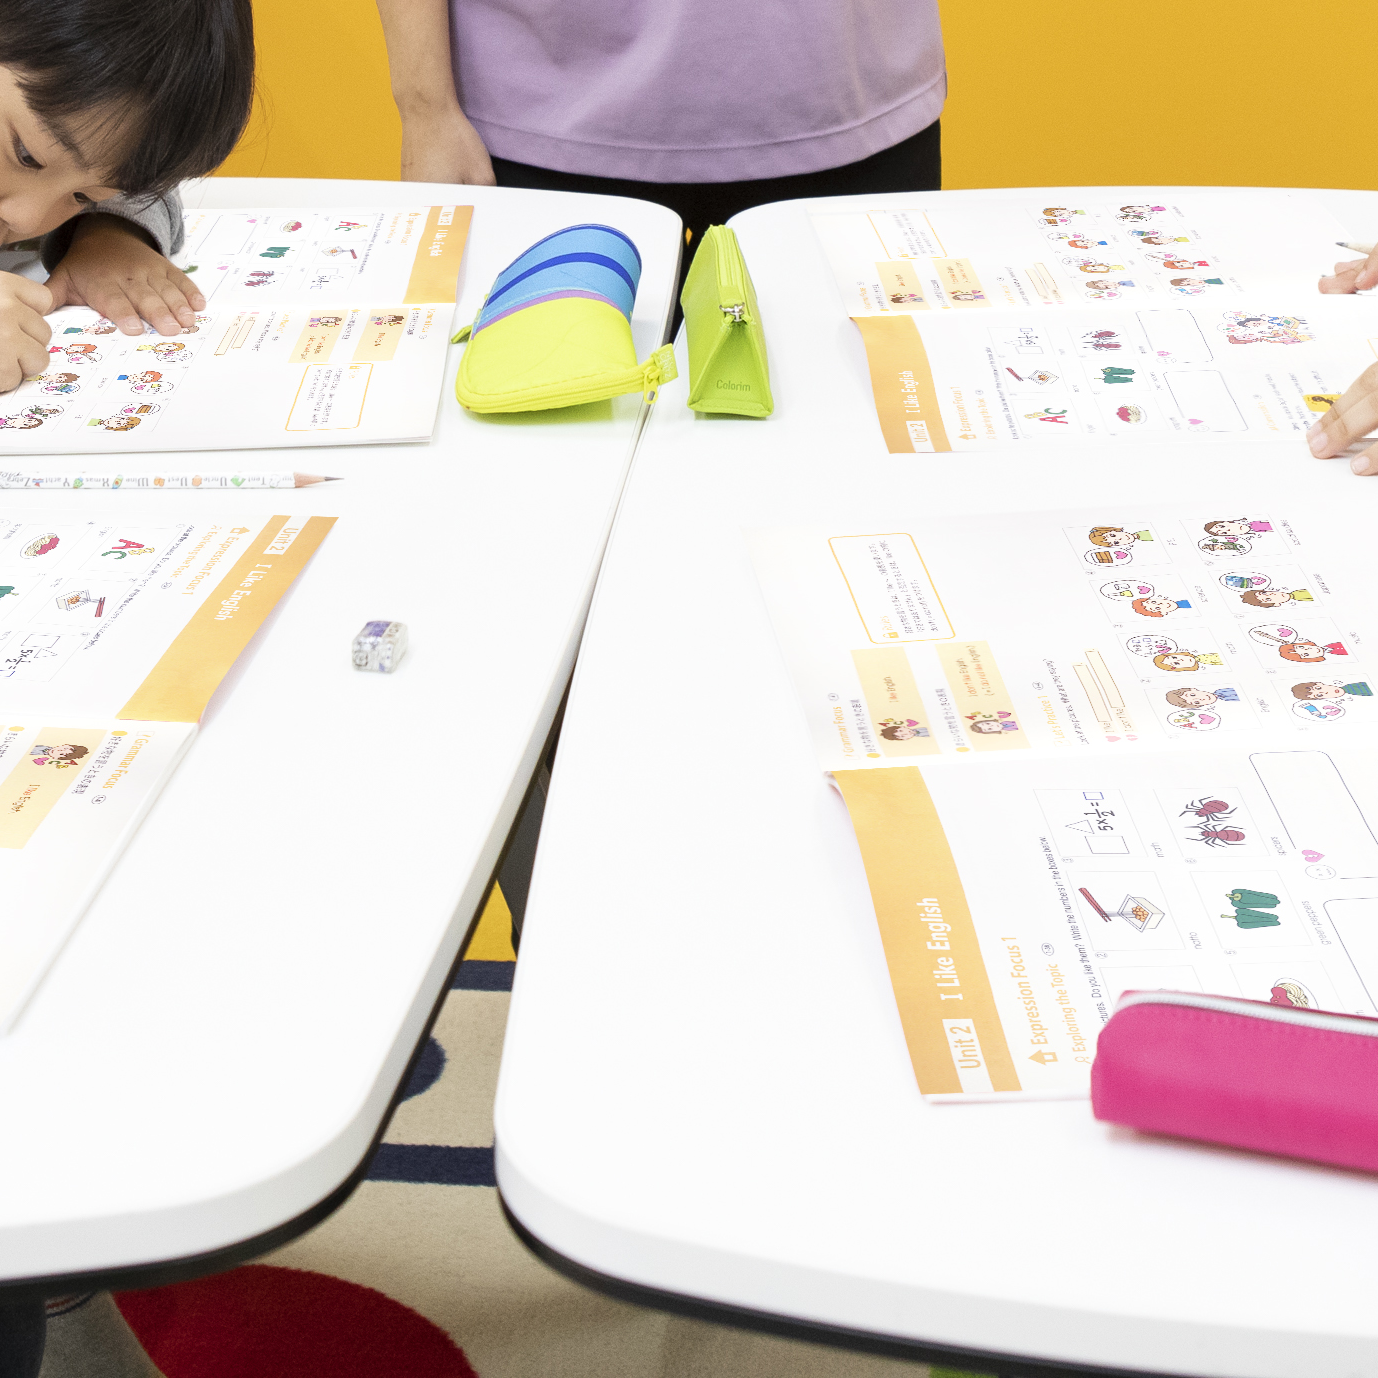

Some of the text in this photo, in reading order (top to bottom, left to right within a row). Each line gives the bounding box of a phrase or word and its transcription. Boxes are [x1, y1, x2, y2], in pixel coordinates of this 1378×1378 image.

[898, 370, 919, 393] English
[903, 395, 920, 408] Like
[952, 390, 964, 404] Focus
[955, 404, 972, 432] Expression
[911, 428, 928, 443] Unit
[45, 476, 71, 487] Yacht
[85, 477, 110, 488] Xmas
[203, 476, 228, 487] Uncle
[188, 531, 218, 558] Exploring
[268, 527, 300, 552] Unit 2
[201, 536, 240, 575] Expression
[185, 571, 211, 592] Focus
[240, 570, 268, 588] Like
[213, 589, 252, 621] English
[832, 706, 847, 727] Focus
[1040, 699, 1059, 725] Practice
[839, 726, 855, 758] Grammar
[1050, 725, 1066, 740] Let's
[102, 738, 150, 790] Grammar Focus
[1150, 841, 1165, 858] math
[1045, 852, 1058, 871] boxes
[1057, 887, 1073, 915] numbers
[1070, 925, 1082, 941] Write
[1301, 900, 1332, 946] green peppers
[916, 897, 964, 1001] I Like English
[1188, 930, 1203, 950] natto
[1007, 945, 1028, 979] Focus
[1074, 943, 1090, 965] them?
[1082, 964, 1094, 975] like
[1086, 975, 1101, 988] you
[1091, 988, 1103, 999] Do
[1017, 981, 1049, 1046] Expression
[1046, 963, 1087, 1053] Exploring the Topic
[949, 1025, 982, 1069] Unit 2
